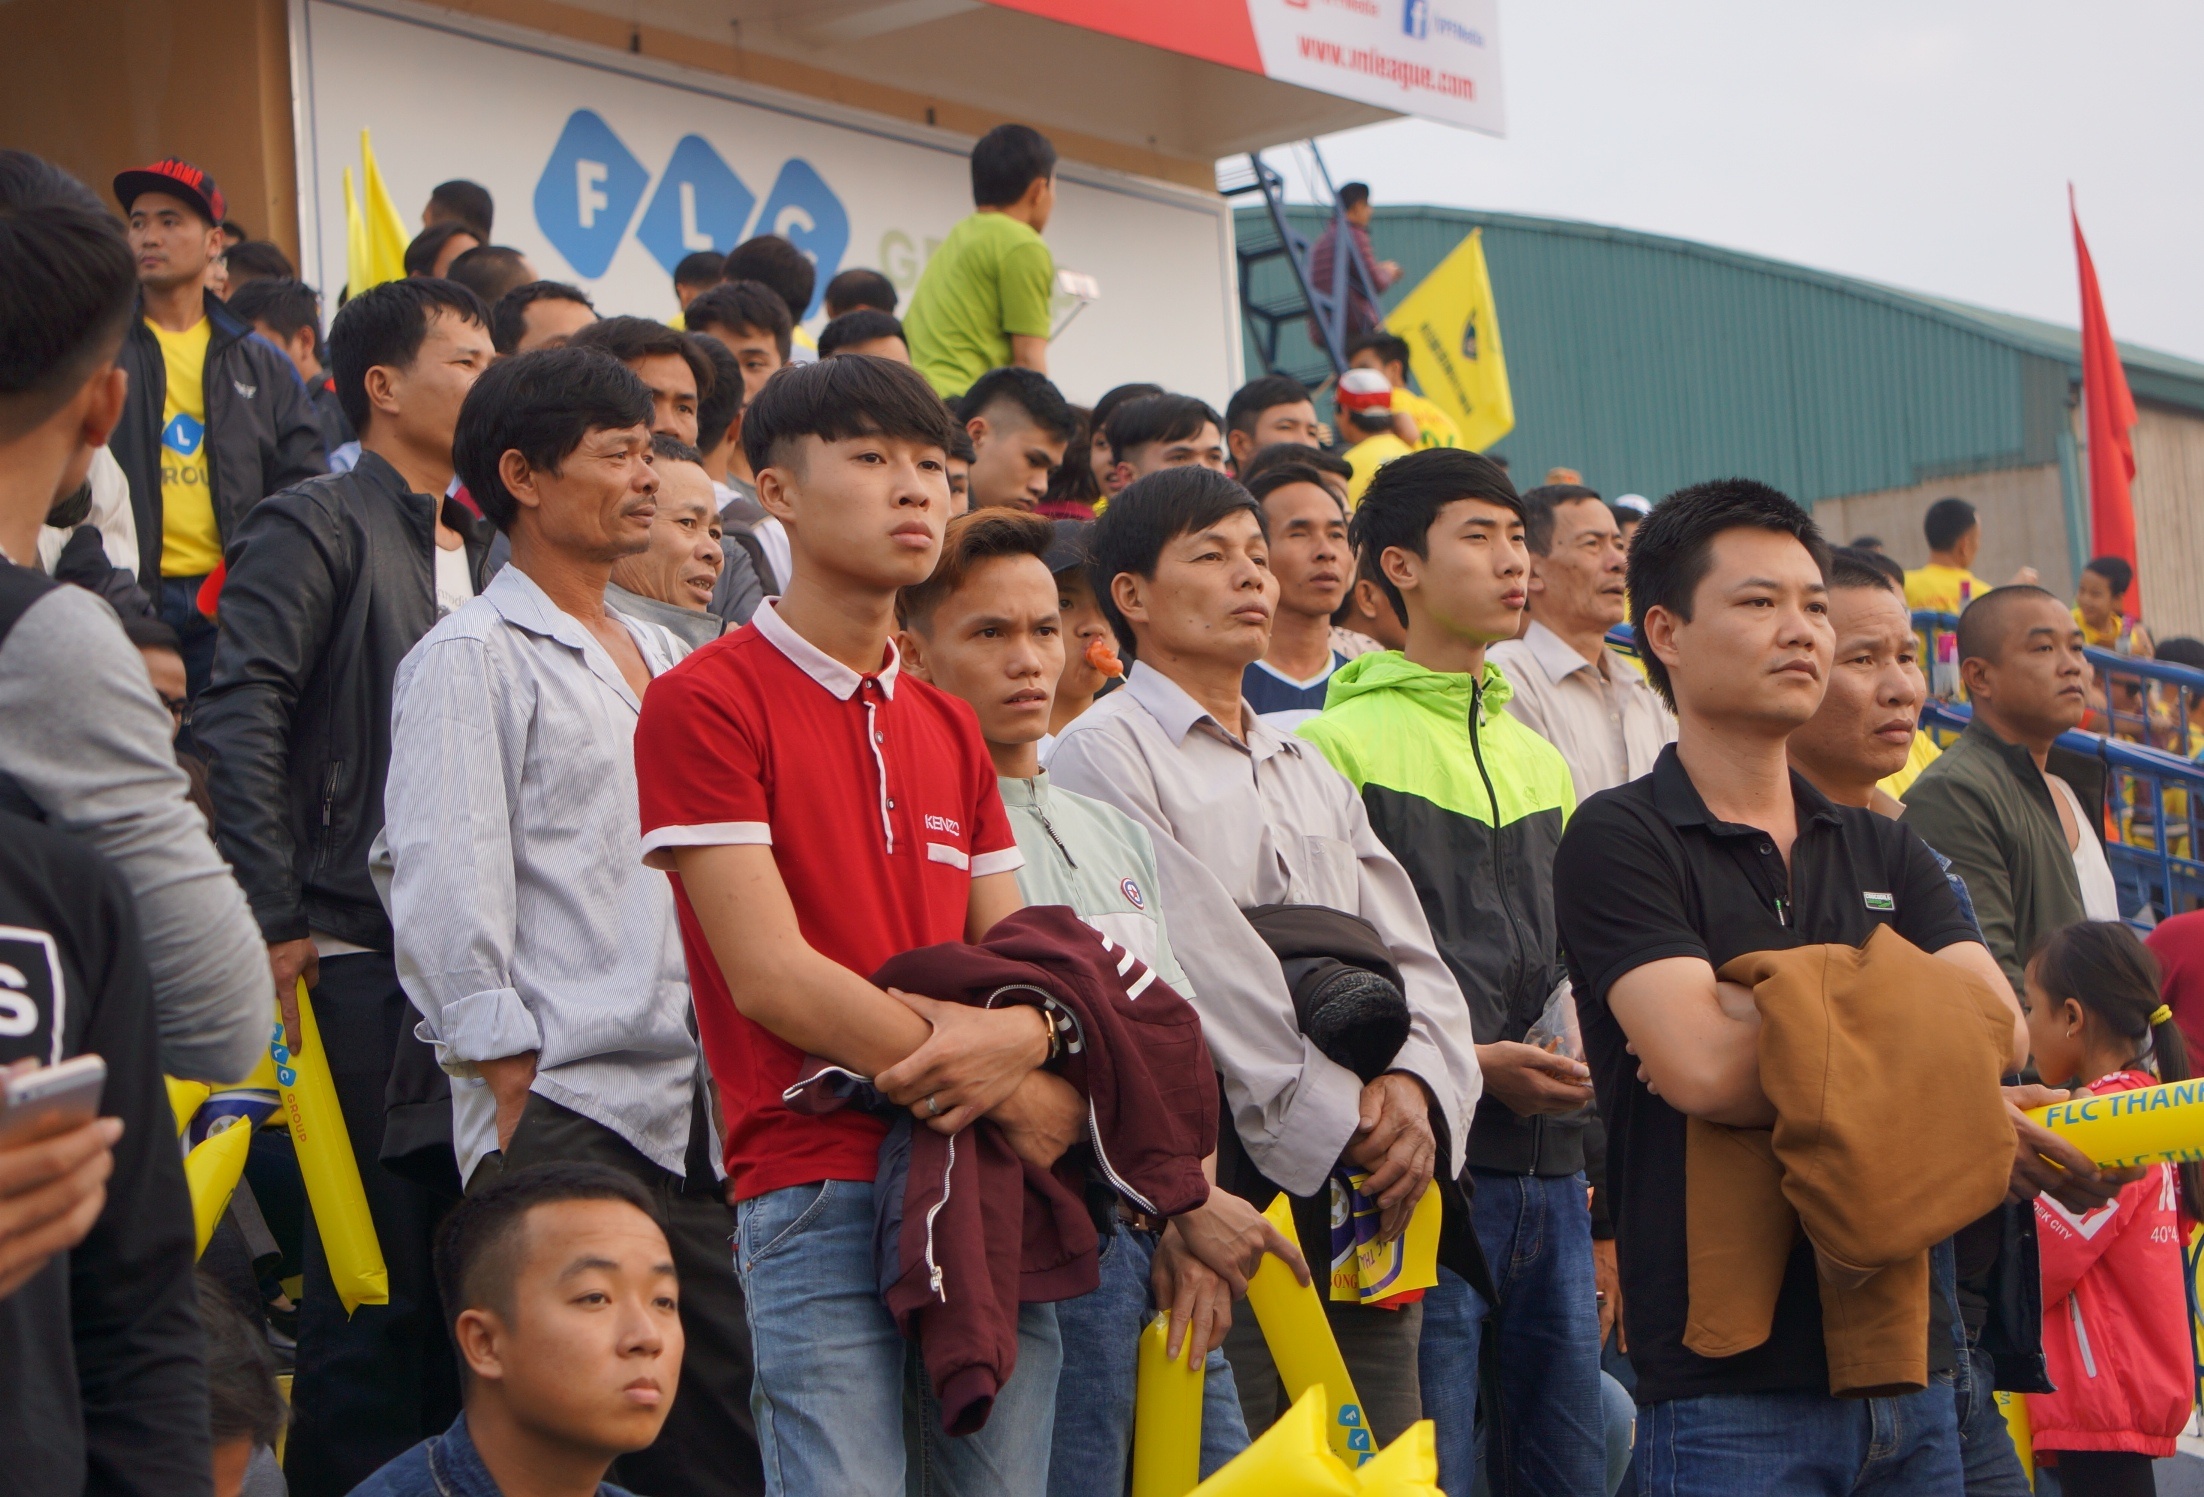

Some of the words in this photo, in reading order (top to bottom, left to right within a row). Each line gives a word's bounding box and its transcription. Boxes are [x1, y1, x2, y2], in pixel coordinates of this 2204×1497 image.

[576, 159, 820, 265] FLC
[286, 1093, 307, 1143] GROUP
[2046, 1099, 2100, 1128] FLC
[2049, 1217, 2073, 1241] CITY
[1330, 1269, 1358, 1289] ÓNG
